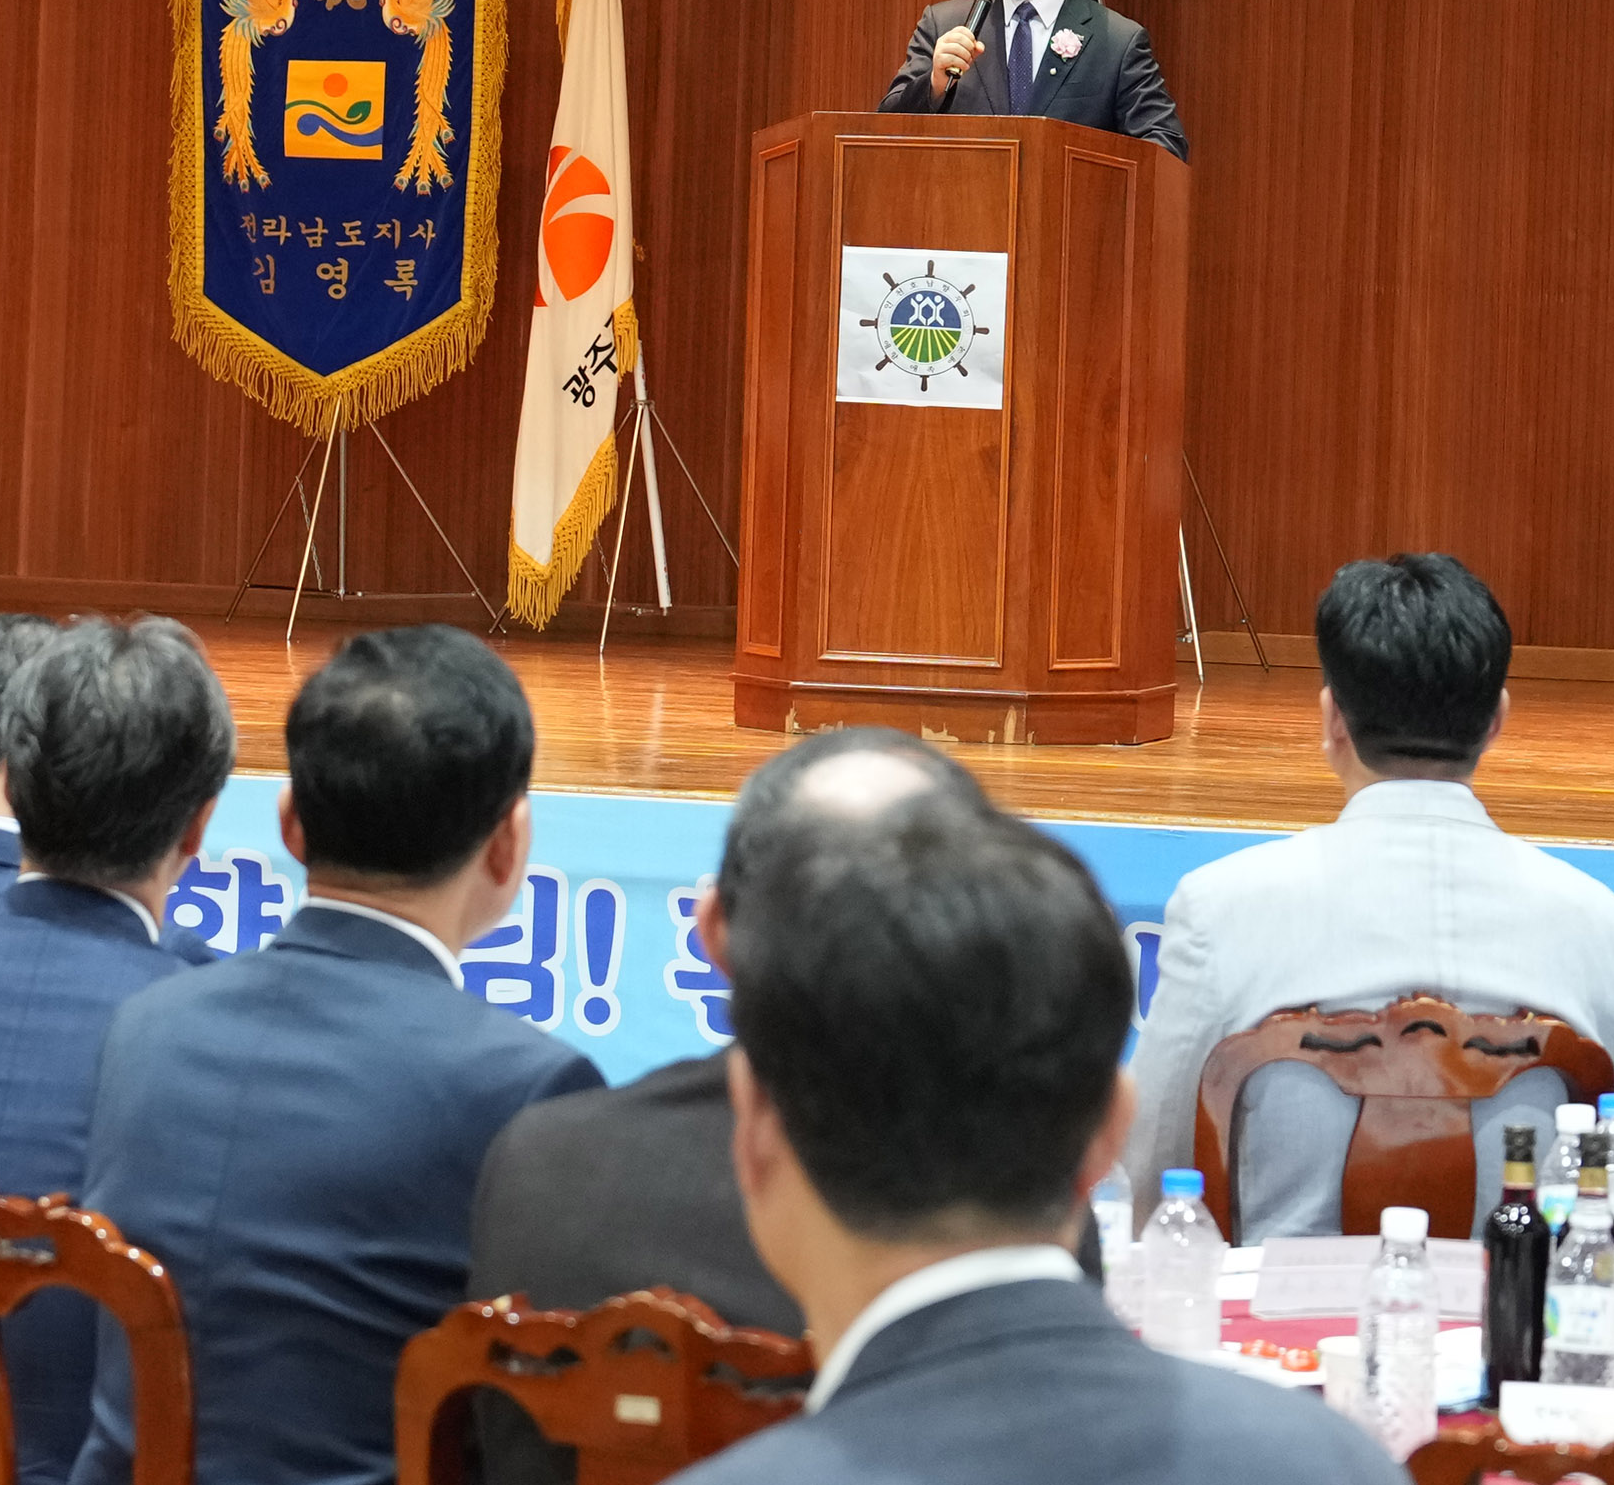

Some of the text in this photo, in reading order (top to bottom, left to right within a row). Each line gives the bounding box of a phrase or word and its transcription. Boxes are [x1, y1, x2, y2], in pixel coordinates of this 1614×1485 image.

[240, 212, 436, 250] 전라남도지사
[252, 254, 419, 300] 김 영 록
[562, 312, 618, 408] 광주
